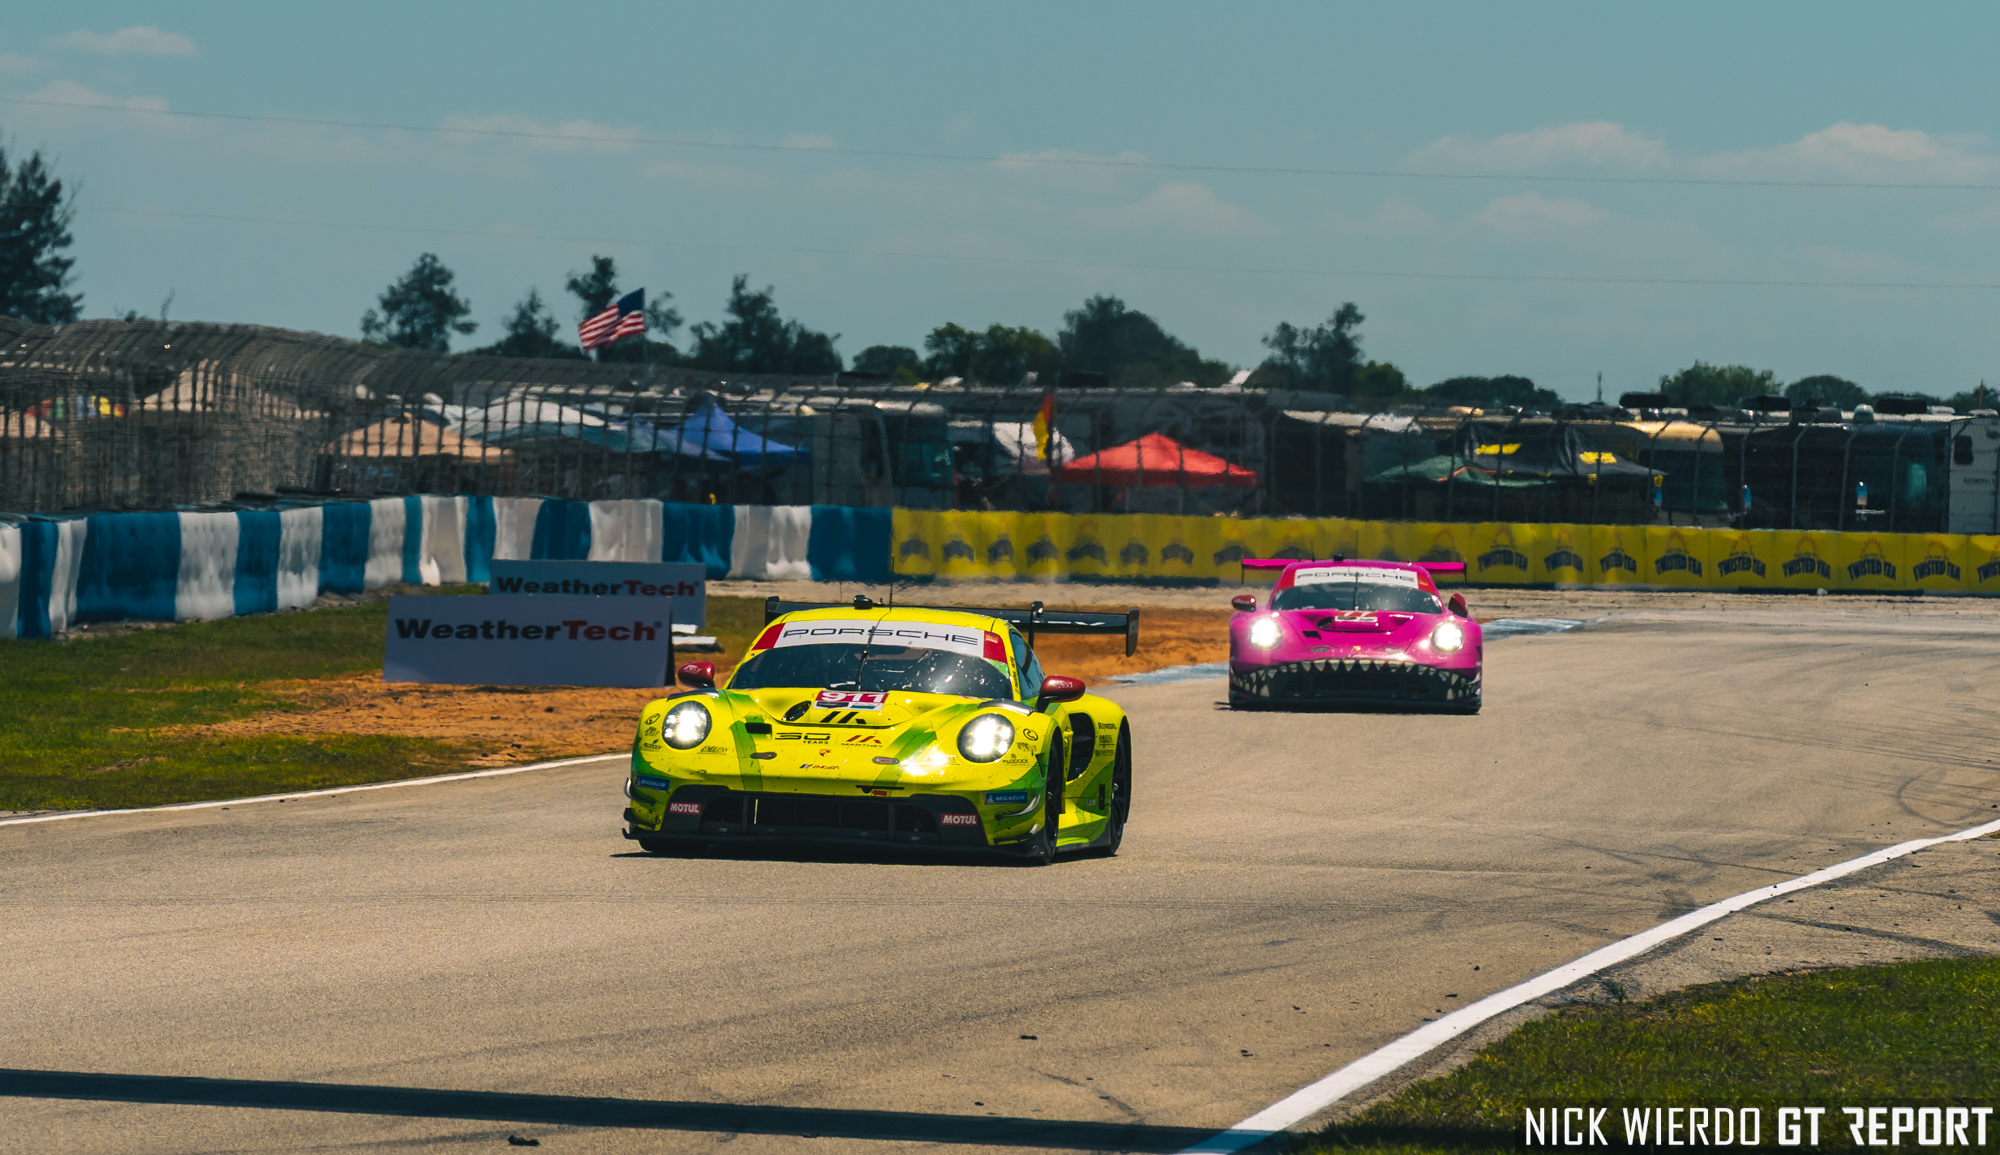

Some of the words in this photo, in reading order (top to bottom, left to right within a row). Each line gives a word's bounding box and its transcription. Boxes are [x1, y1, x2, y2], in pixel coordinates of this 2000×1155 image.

[1718, 556, 1751, 577] TWISTED
[1752, 558, 1766, 579] TEA
[1782, 557, 1816, 579] TWISTED
[1817, 559, 1831, 580] TEA
[1847, 558, 1882, 581] TWISTED
[1883, 560, 1896, 581] TEA
[1913, 560, 1946, 582] TWISTED
[1947, 561, 1960, 582] TEA
[1297, 572, 1415, 582] PORSCHE
[783, 628, 978, 646] PORSCHE
[821, 692, 885, 702] 911
[775, 732, 831, 741] 30
[640, 778, 667, 788] MICHELIN
[670, 803, 700, 813] MOTUL
[942, 815, 977, 824] MOTUL
